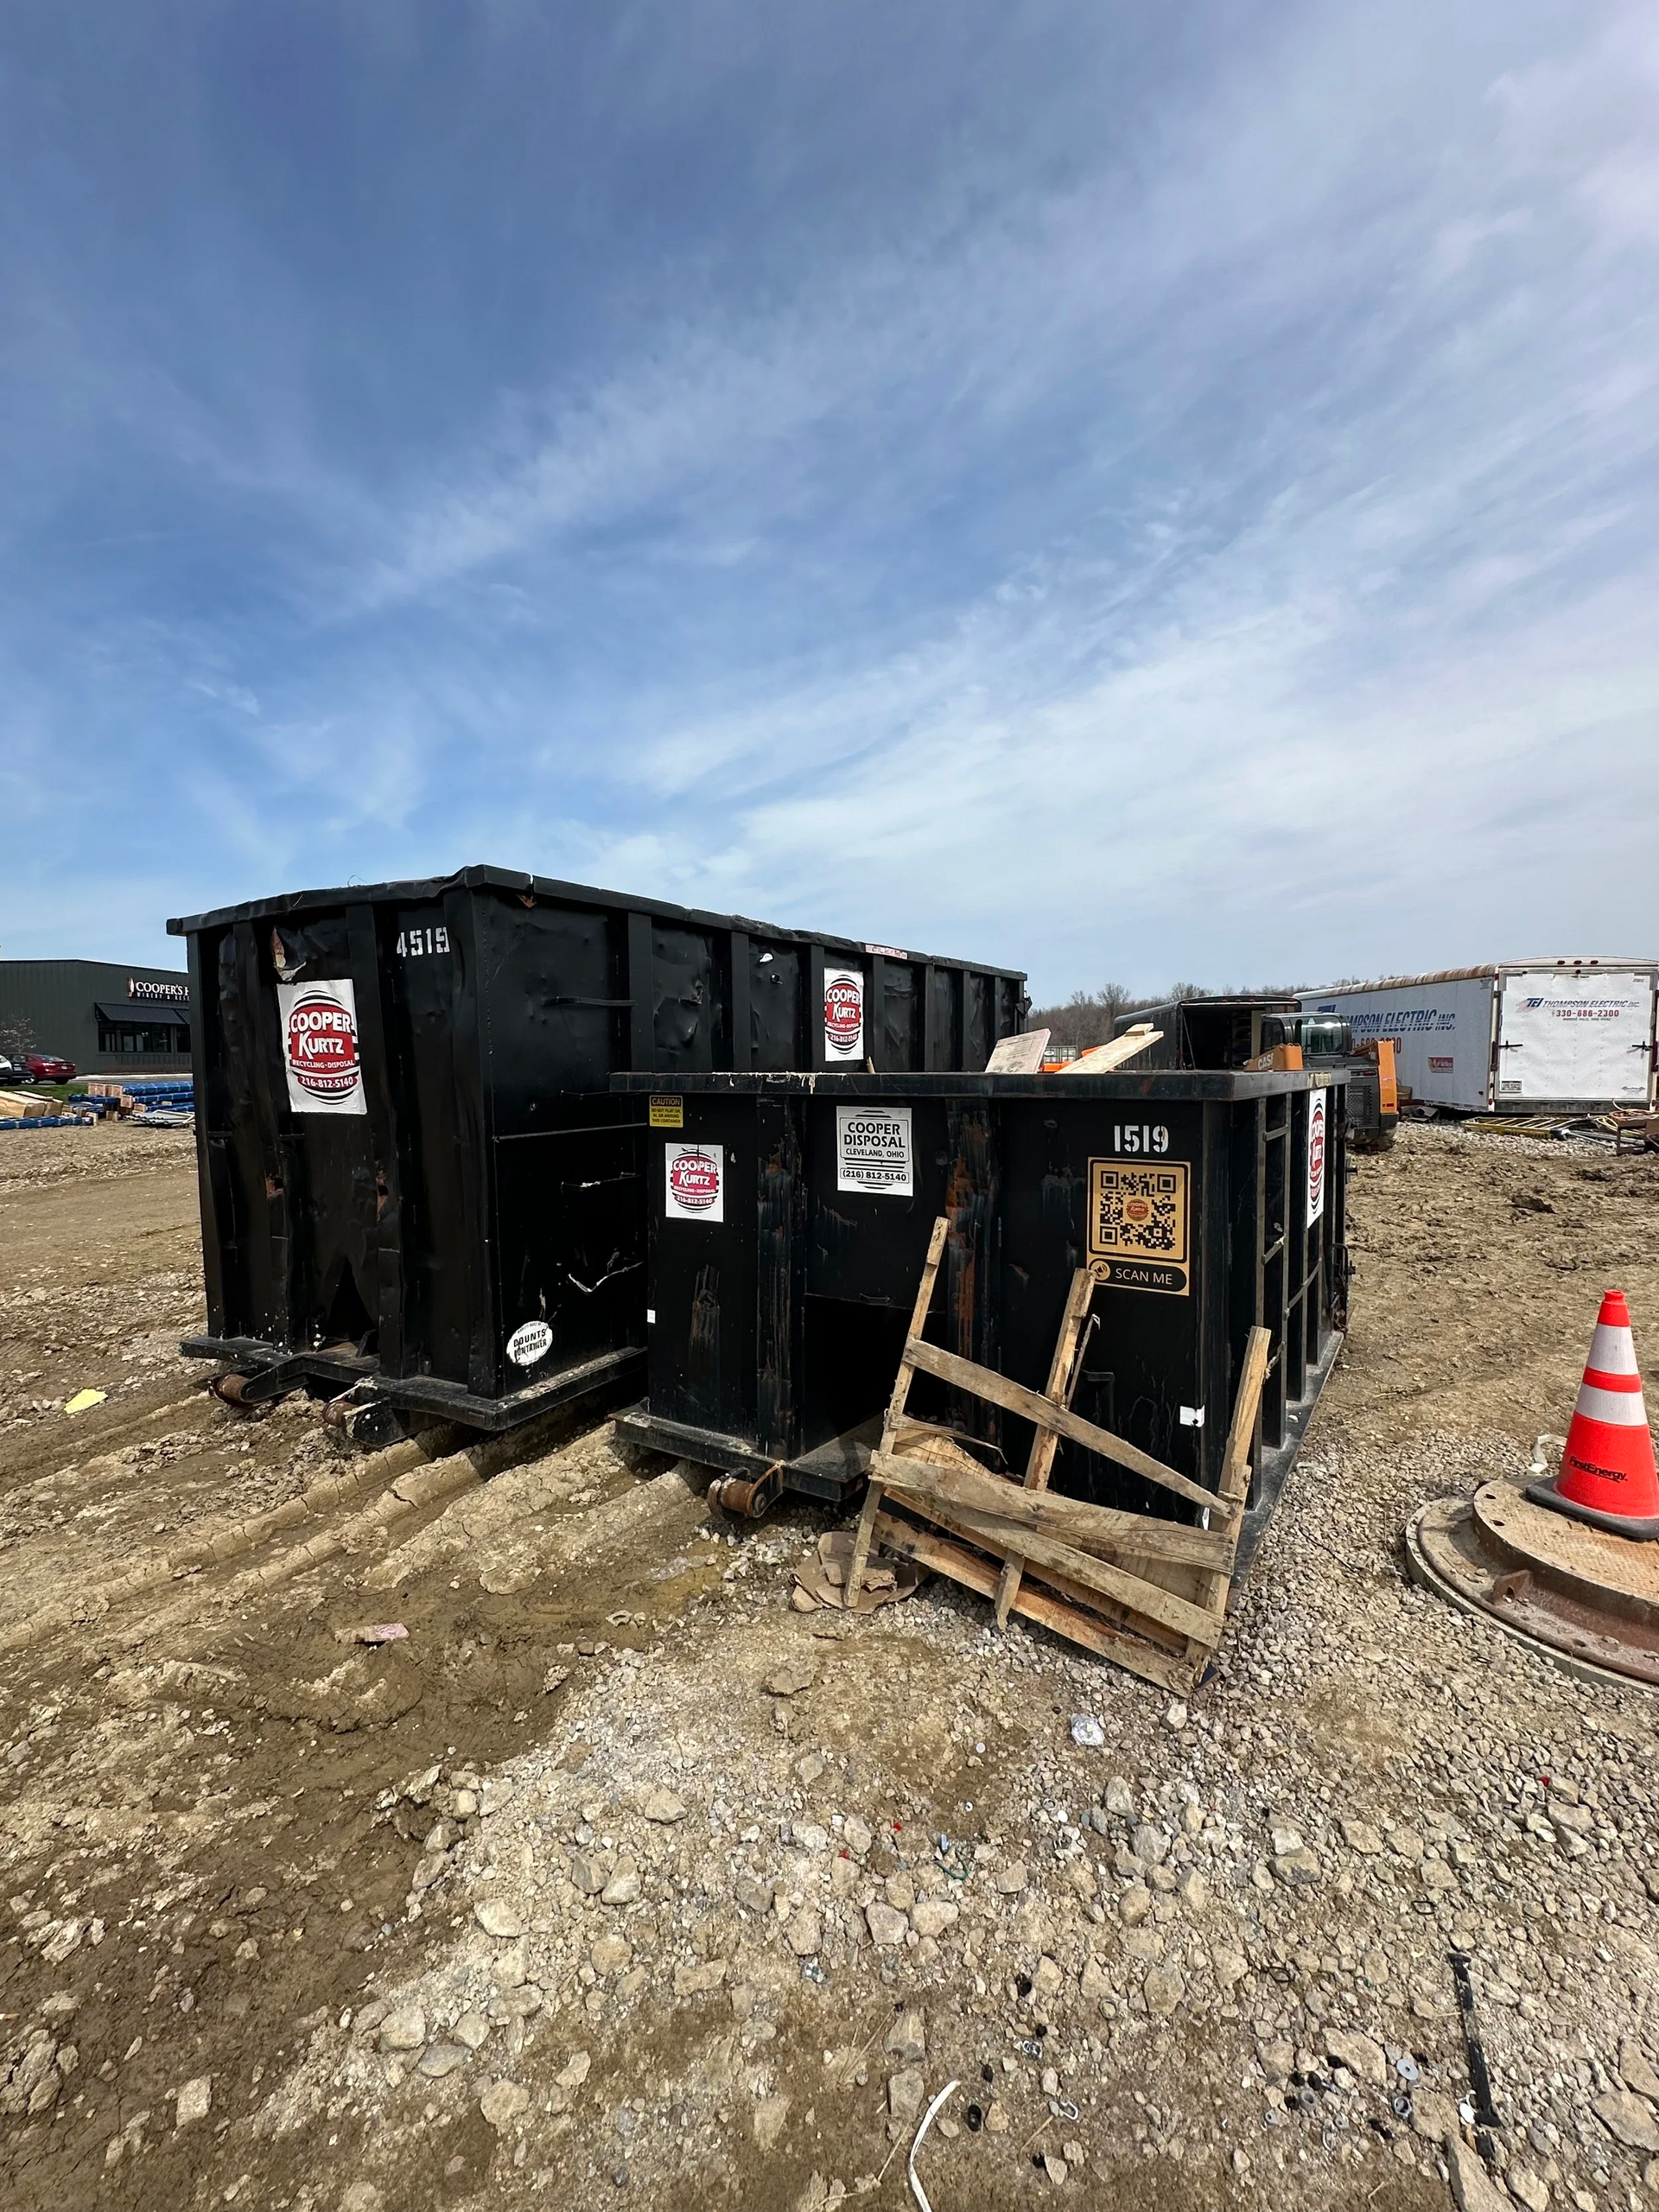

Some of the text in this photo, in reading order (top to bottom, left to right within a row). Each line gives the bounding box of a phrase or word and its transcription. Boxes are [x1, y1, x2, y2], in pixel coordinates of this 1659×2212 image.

[397, 926, 450, 957] 4519
[136, 982, 183, 995] COOPER'S
[827, 988, 860, 1005] COOPER
[832, 1002, 856, 1022] KURTZ
[290, 1011, 352, 1033] COOPER
[1347, 1013, 1384, 1033] MPSON
[1382, 1009, 1438, 1032] ELECTRIC
[298, 1031, 345, 1059] KURTZ
[652, 1097, 680, 1106] CAUTION
[848, 1122, 900, 1135] COOPER
[844, 1135, 906, 1147] DISPOSAL
[1114, 1125, 1169, 1153] 1519
[846, 1148, 885, 1158] CLEVELAND,
[673, 1160, 717, 1173] COOPER
[678, 1171, 710, 1186] KURTZ
[842, 1169, 906, 1181] (216) 812-5140
[1116, 1268, 1173, 1285] SCAN ME
